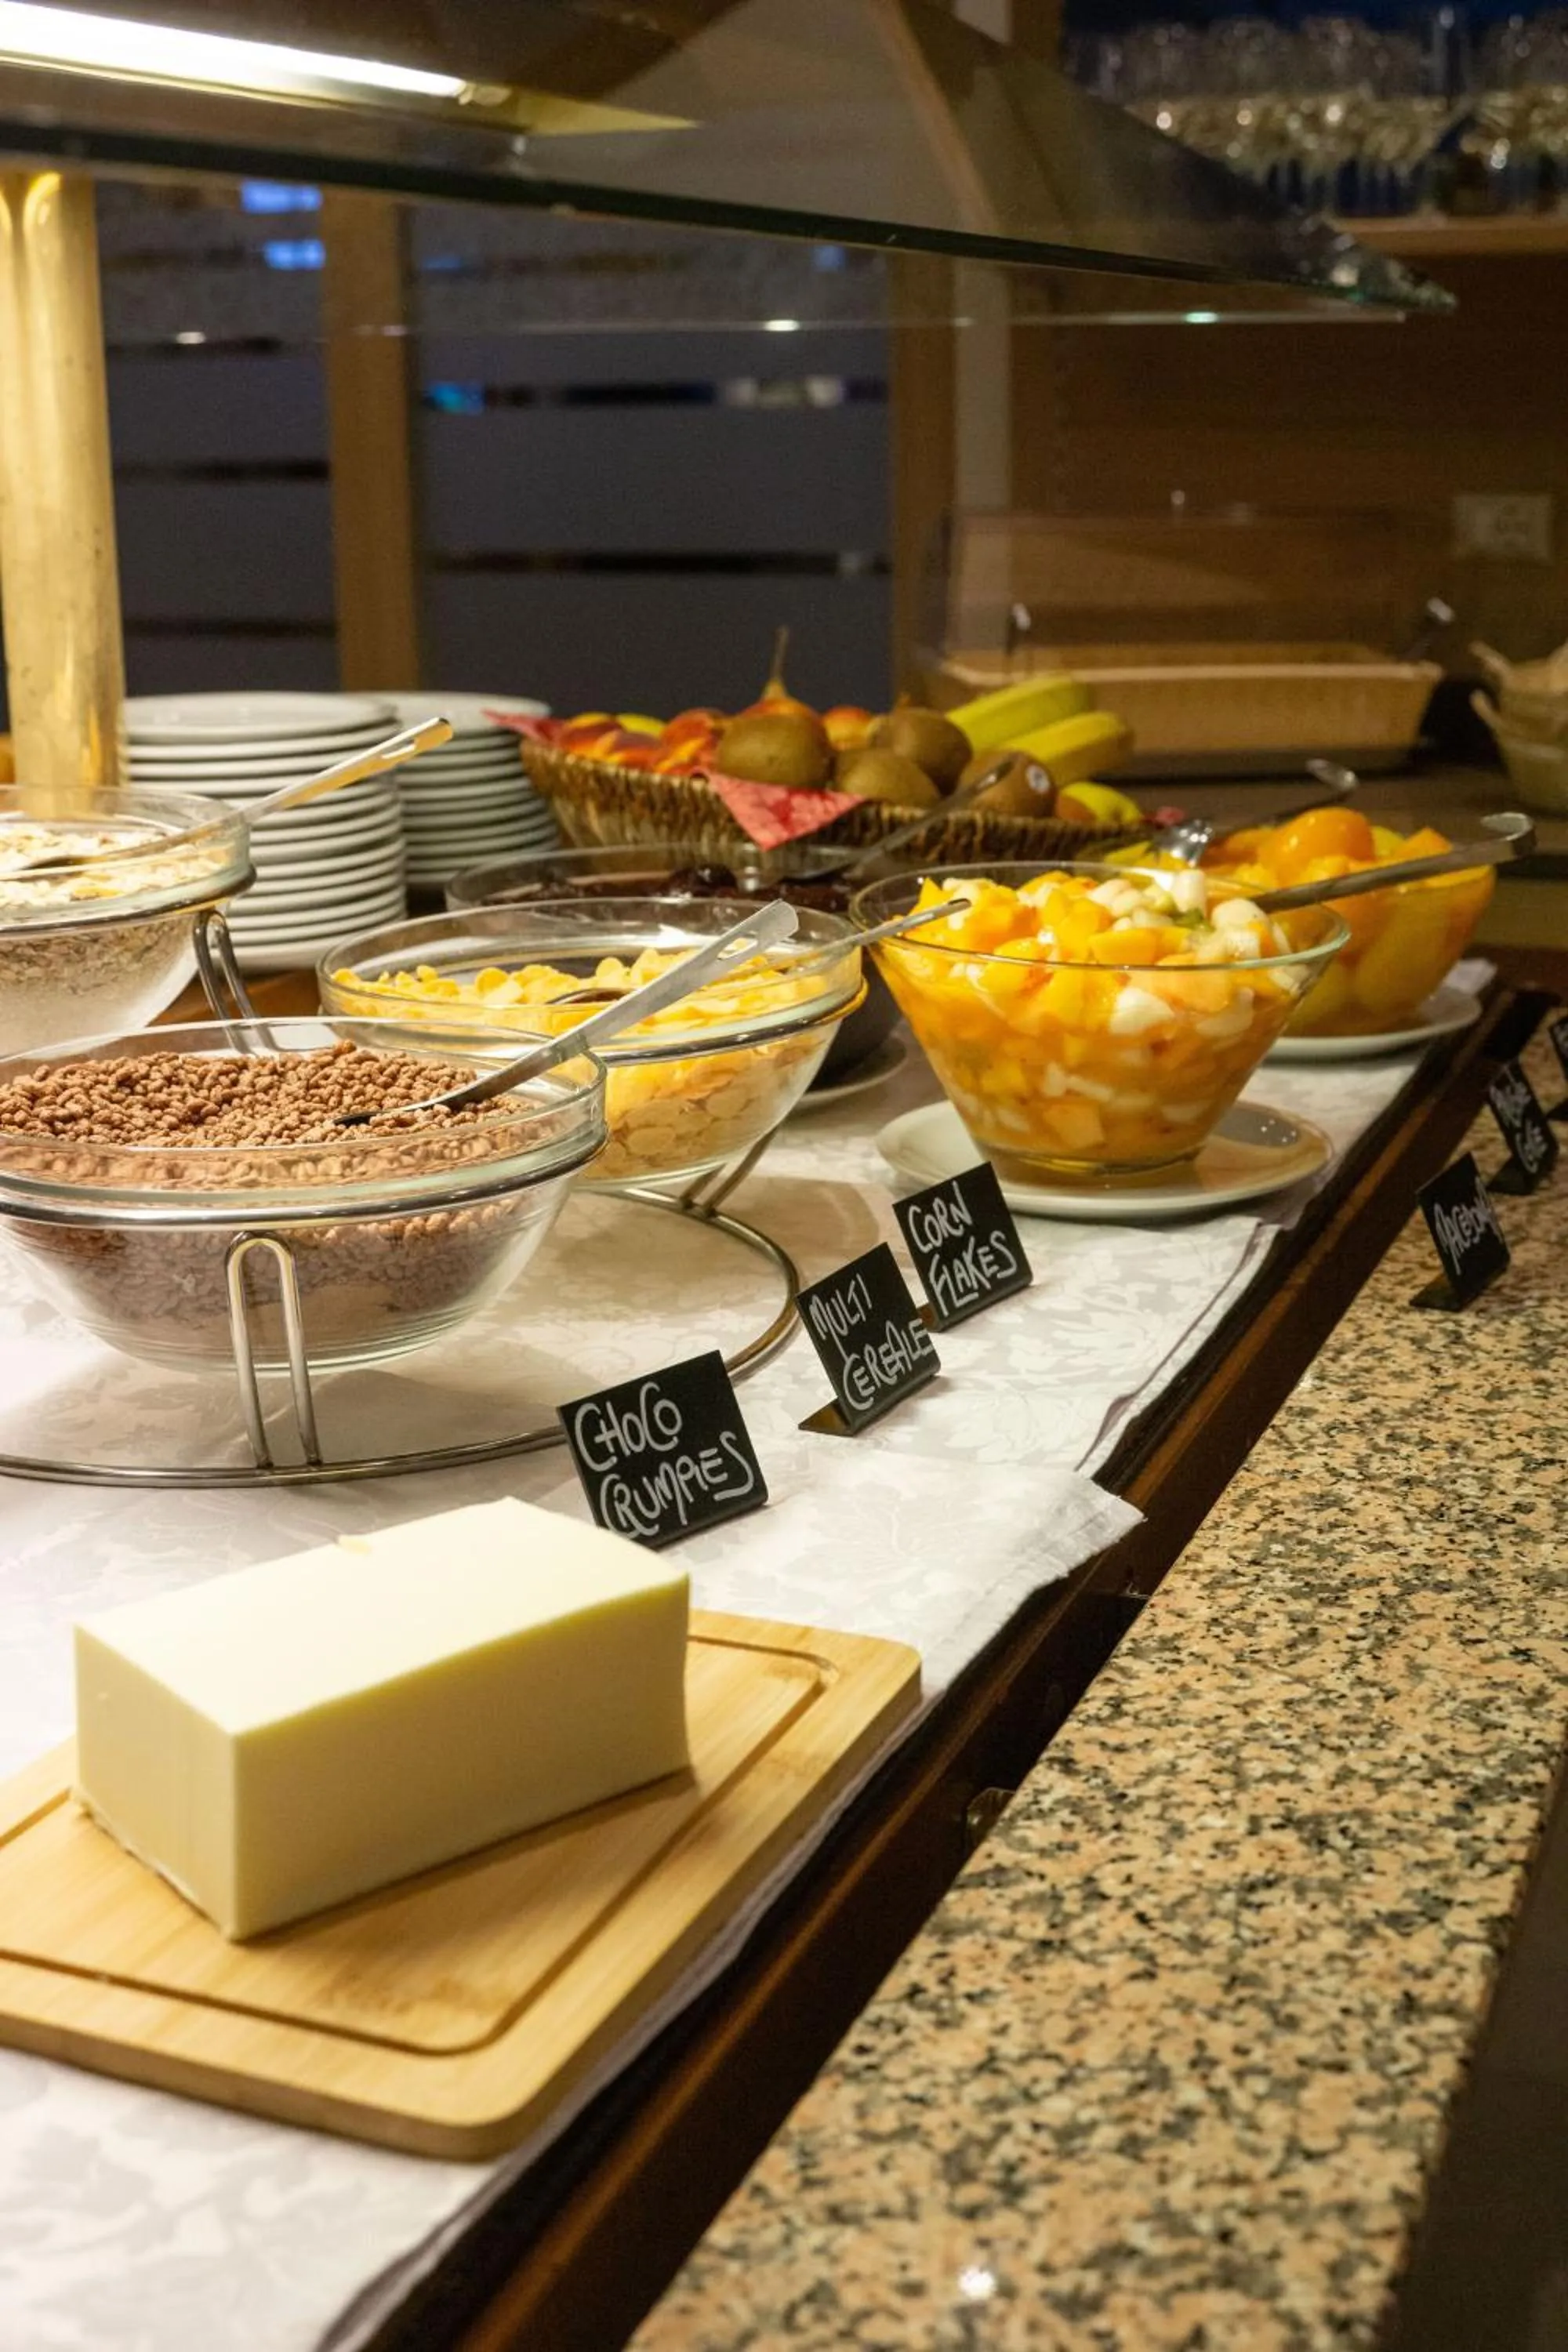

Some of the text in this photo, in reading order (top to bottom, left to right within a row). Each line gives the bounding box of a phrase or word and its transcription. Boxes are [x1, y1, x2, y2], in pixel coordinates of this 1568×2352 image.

[908, 1181, 973, 1255] CORN
[809, 1273, 873, 1359] MULTI
[927, 1230, 1018, 1318] FLAKES
[844, 1319, 936, 1411] CEREALE
[574, 1381, 684, 1472] CHOCO
[599, 1431, 755, 1539] CRUMPIES
